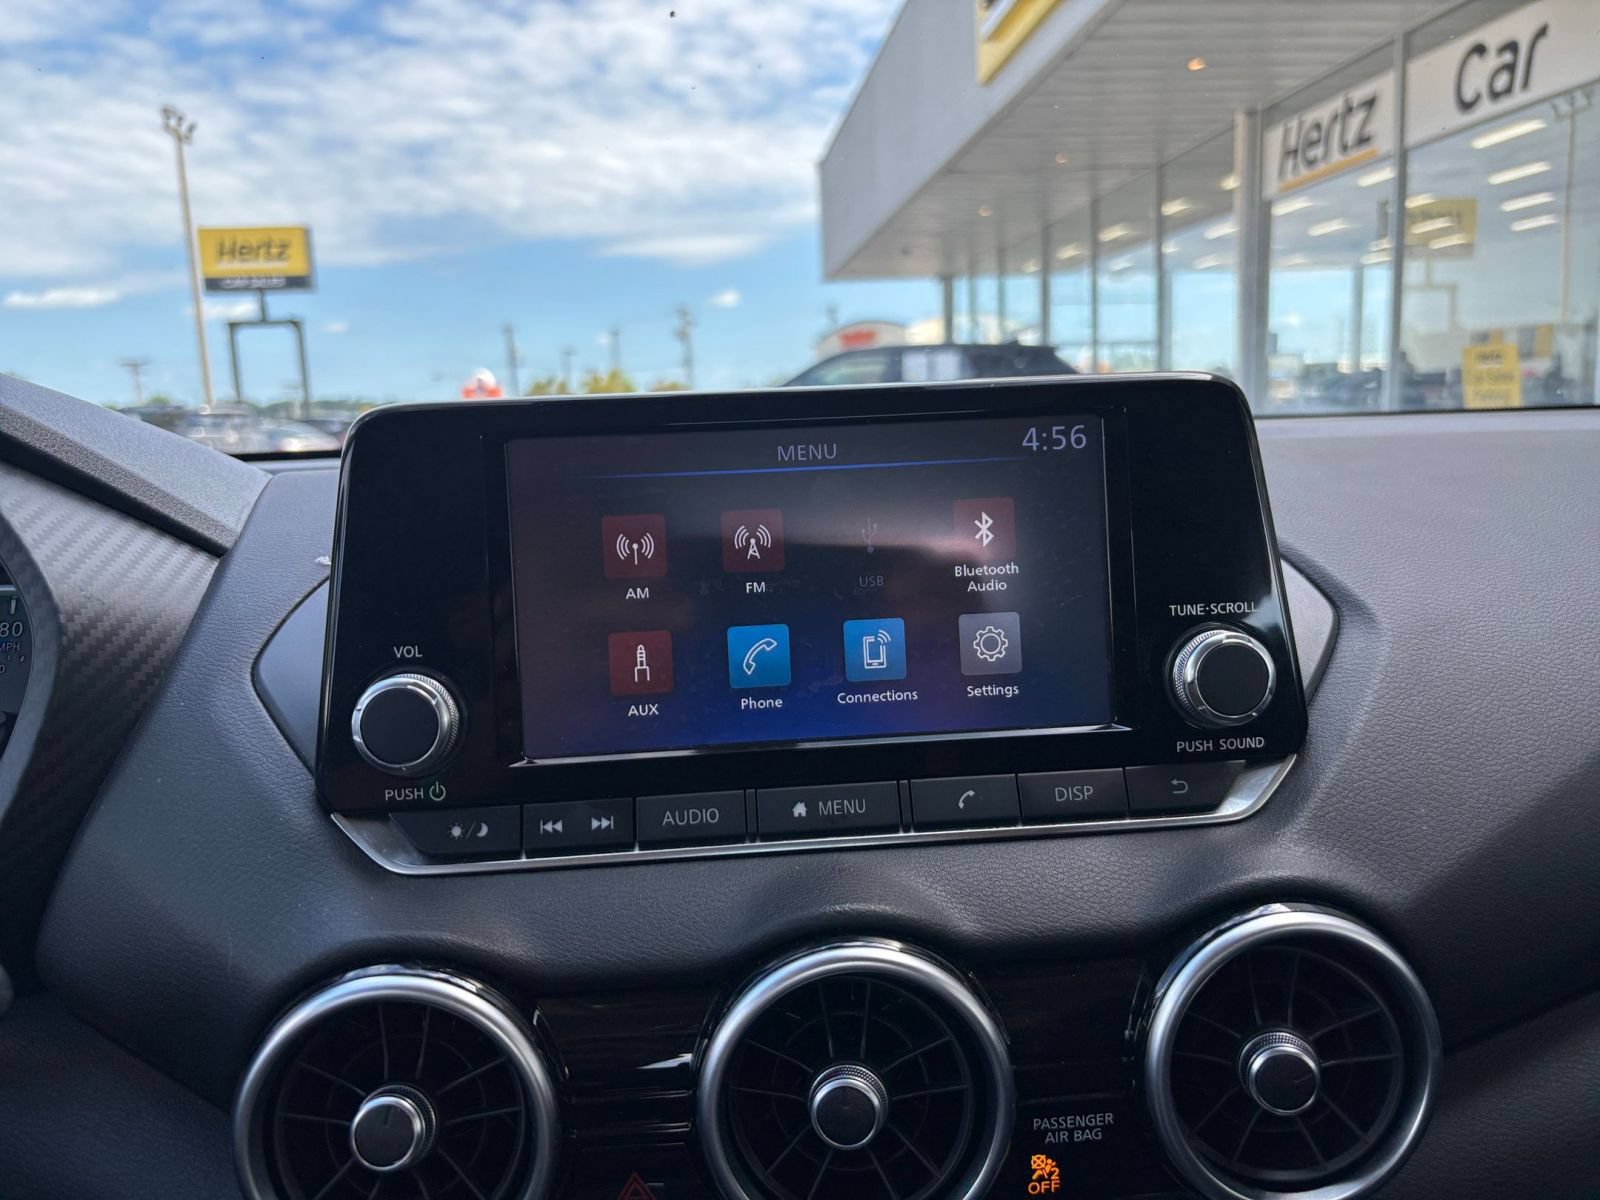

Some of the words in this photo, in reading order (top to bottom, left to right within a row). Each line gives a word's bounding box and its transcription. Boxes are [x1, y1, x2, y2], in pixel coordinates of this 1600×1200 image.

[1455, 23, 1548, 115] Car
[1279, 91, 1377, 180] Hertz
[217, 237, 292, 262] Hertz
[1021, 424, 1087, 451] 4:56
[777, 443, 838, 461] MENU
[954, 562, 1019, 577] Bluetooth
[745, 582, 766, 594] FM
[859, 575, 884, 588] USB
[967, 580, 1007, 592] Audio
[625, 587, 650, 600] AM
[393, 645, 423, 658] VOL
[837, 690, 918, 704] Connections
[966, 684, 1019, 697] Settings
[627, 704, 659, 717] AUX
[740, 697, 783, 710] Phone
[1176, 740, 1213, 753] PUSH
[1219, 736, 1265, 750] SOUND
[384, 788, 424, 801] PUSH
[1054, 785, 1094, 802] DISP
[818, 798, 867, 816] MENU
[661, 807, 720, 826] AUDIO
[1033, 1112, 1115, 1131] PASSENGER
[1044, 1131, 1069, 1144] AIR
[1073, 1128, 1103, 1142] BAG
[1027, 1180, 1061, 1195] OFF
